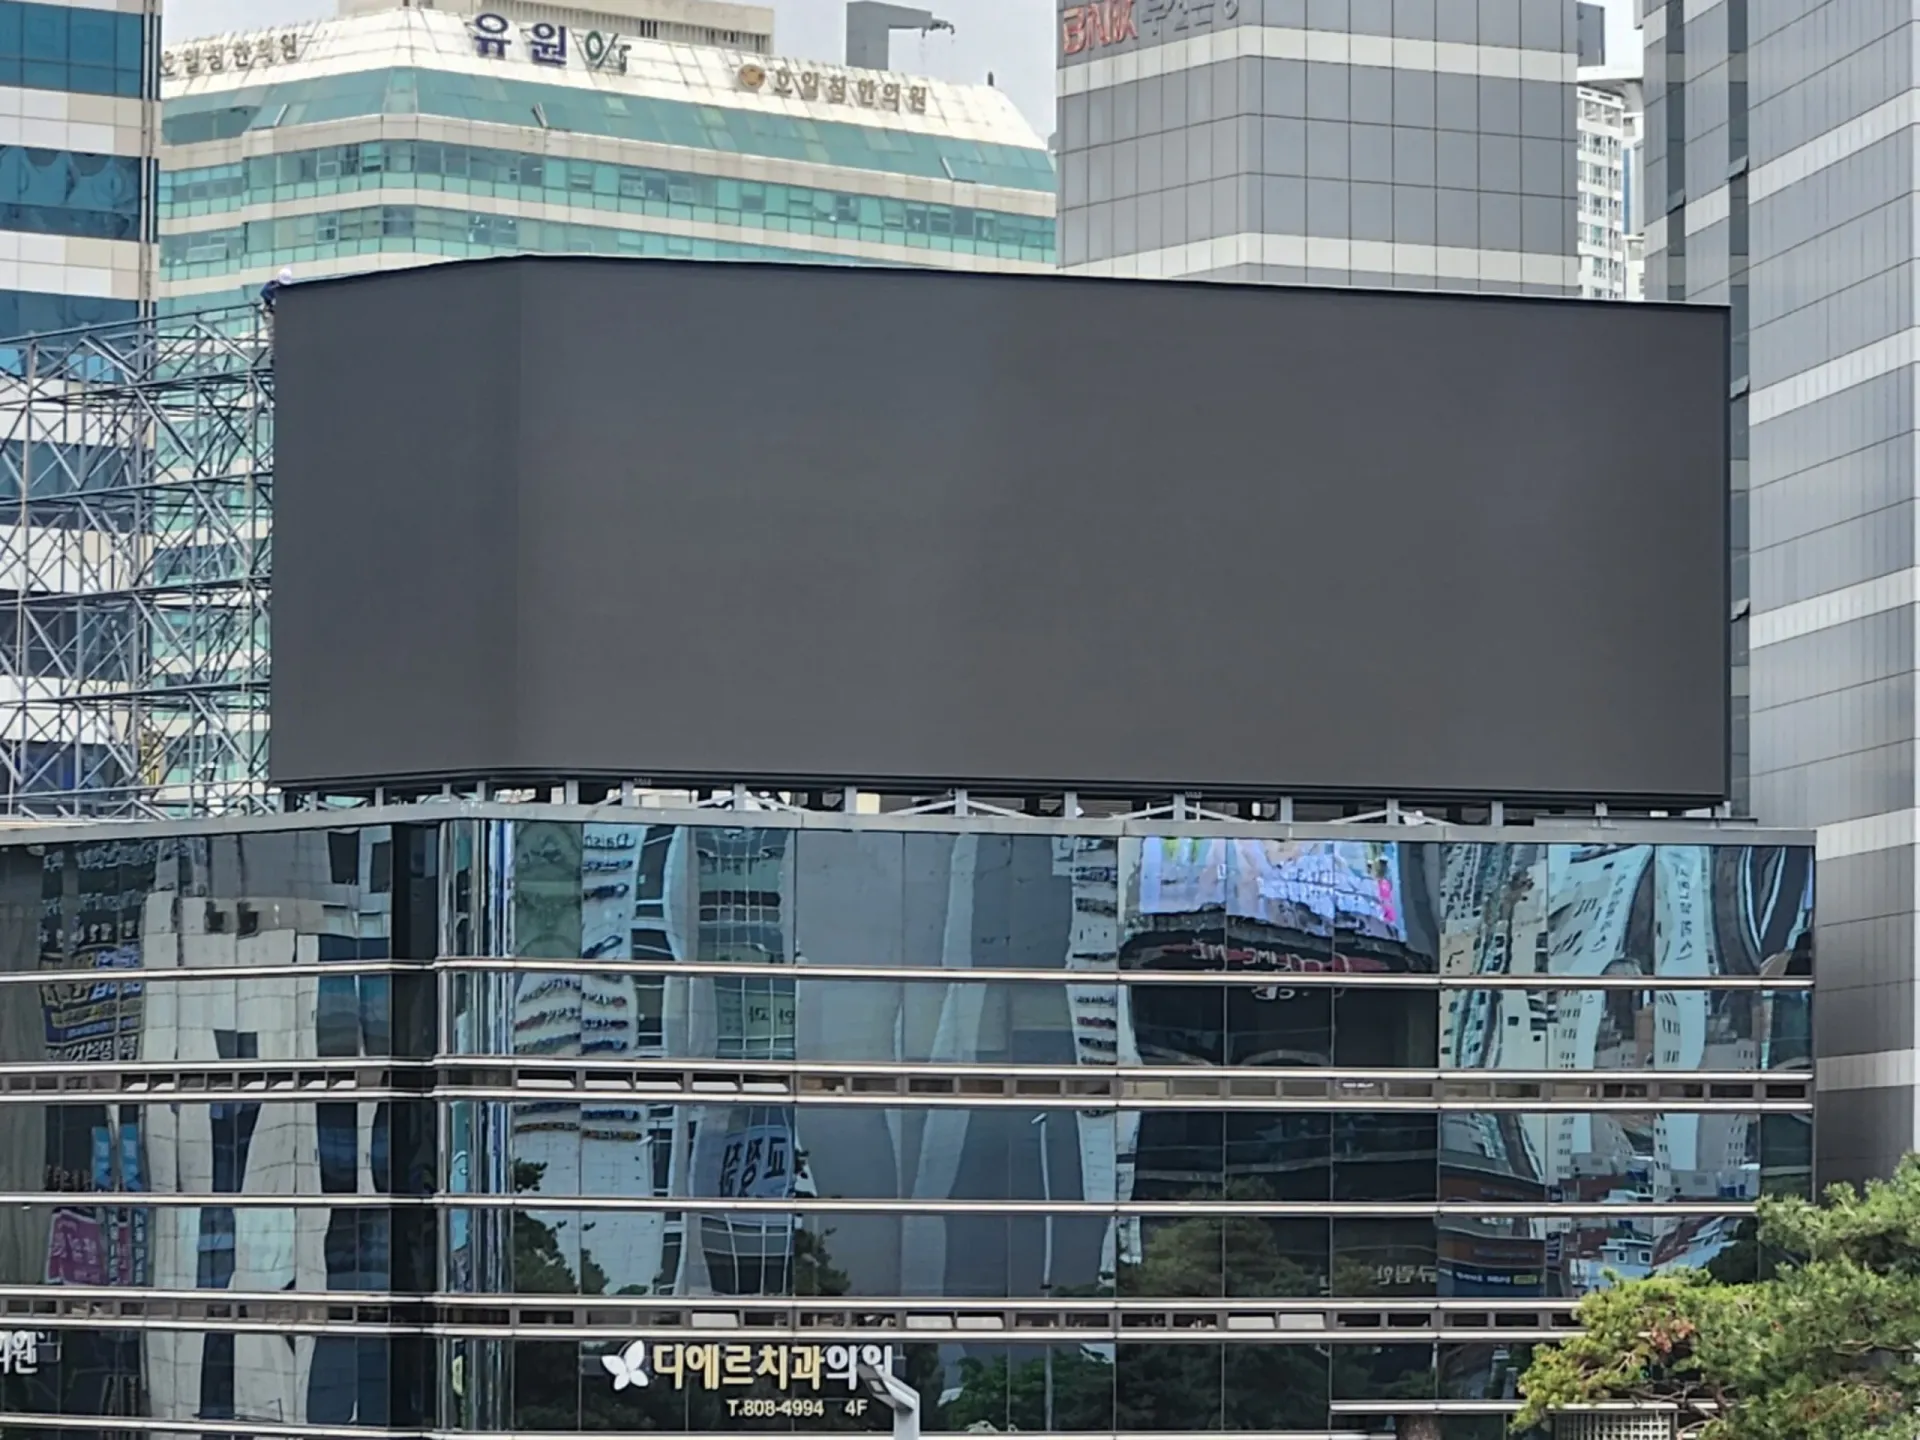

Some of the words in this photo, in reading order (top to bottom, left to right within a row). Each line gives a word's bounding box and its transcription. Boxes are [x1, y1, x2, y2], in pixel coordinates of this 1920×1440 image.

[474, 13, 568, 68] 유원
[1063, 0, 1139, 55] BNK
[726, 1399, 824, 1417] T.808-4994
[844, 1399, 868, 1417] 4F
